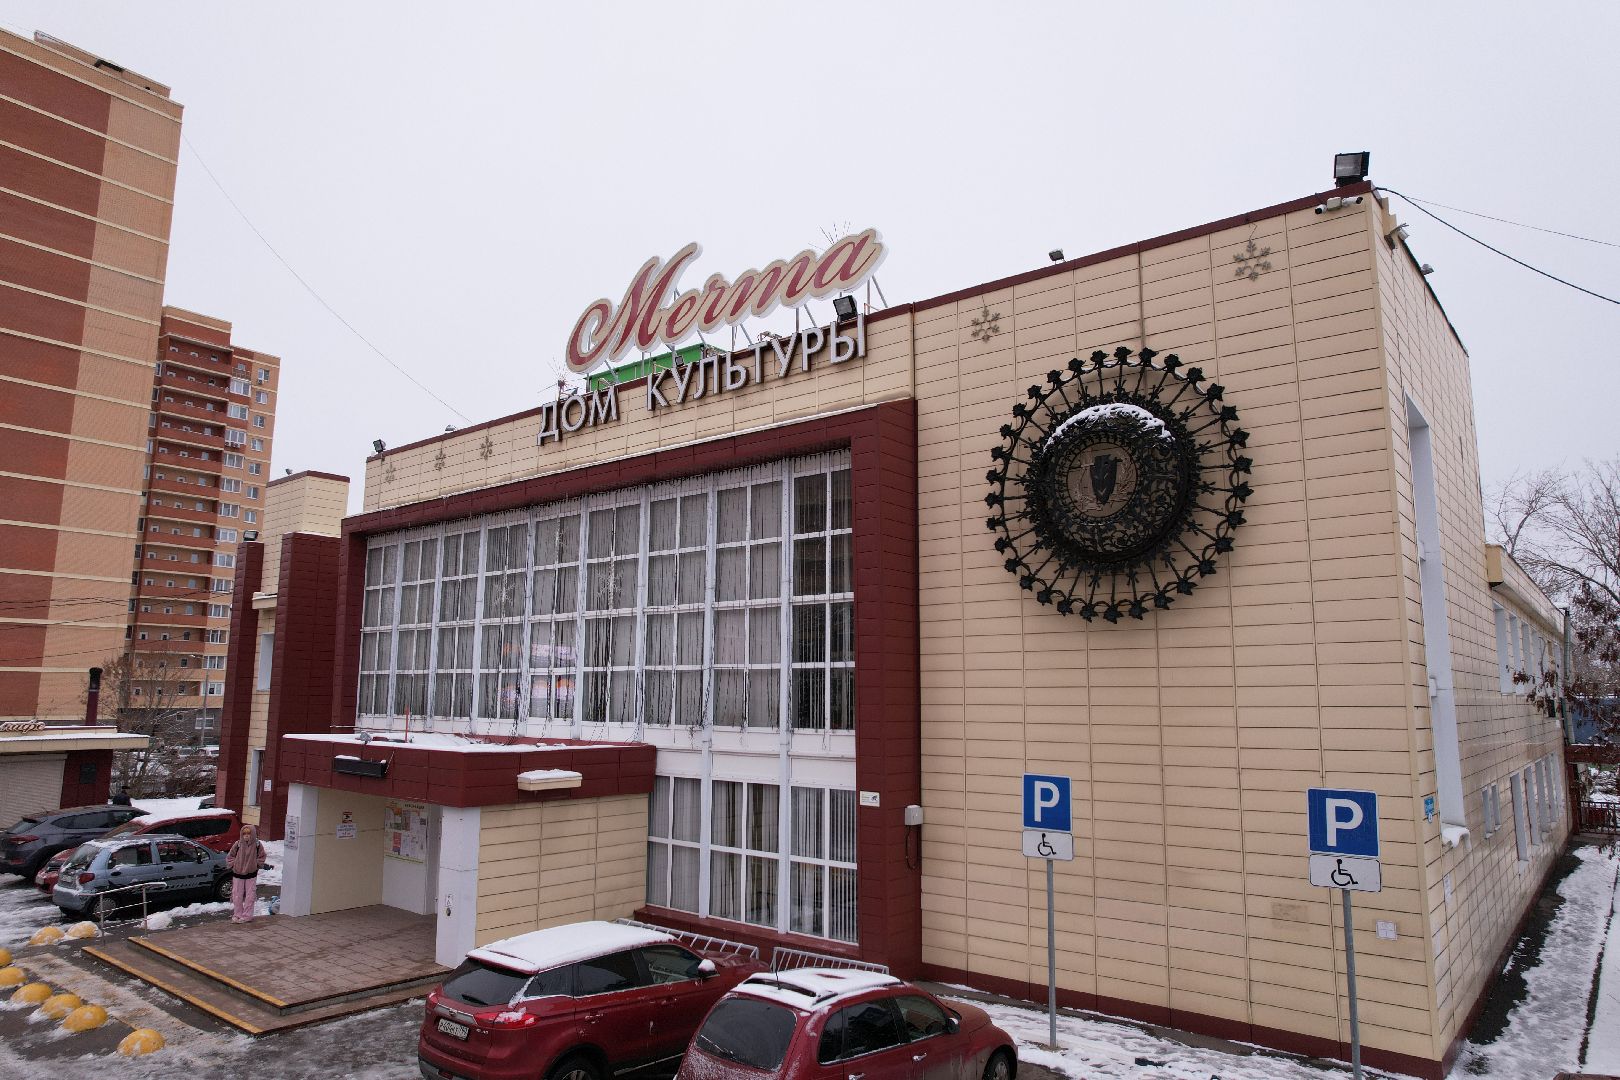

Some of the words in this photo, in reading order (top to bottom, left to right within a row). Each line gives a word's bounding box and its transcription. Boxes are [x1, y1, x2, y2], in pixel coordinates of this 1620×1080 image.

[566, 229, 887, 373] Мечта
[536, 383, 619, 446] ДОМ
[647, 314, 867, 411] КУЛЬТУРЫ
[1033, 780, 1060, 822] P
[1325, 797, 1364, 847] P
